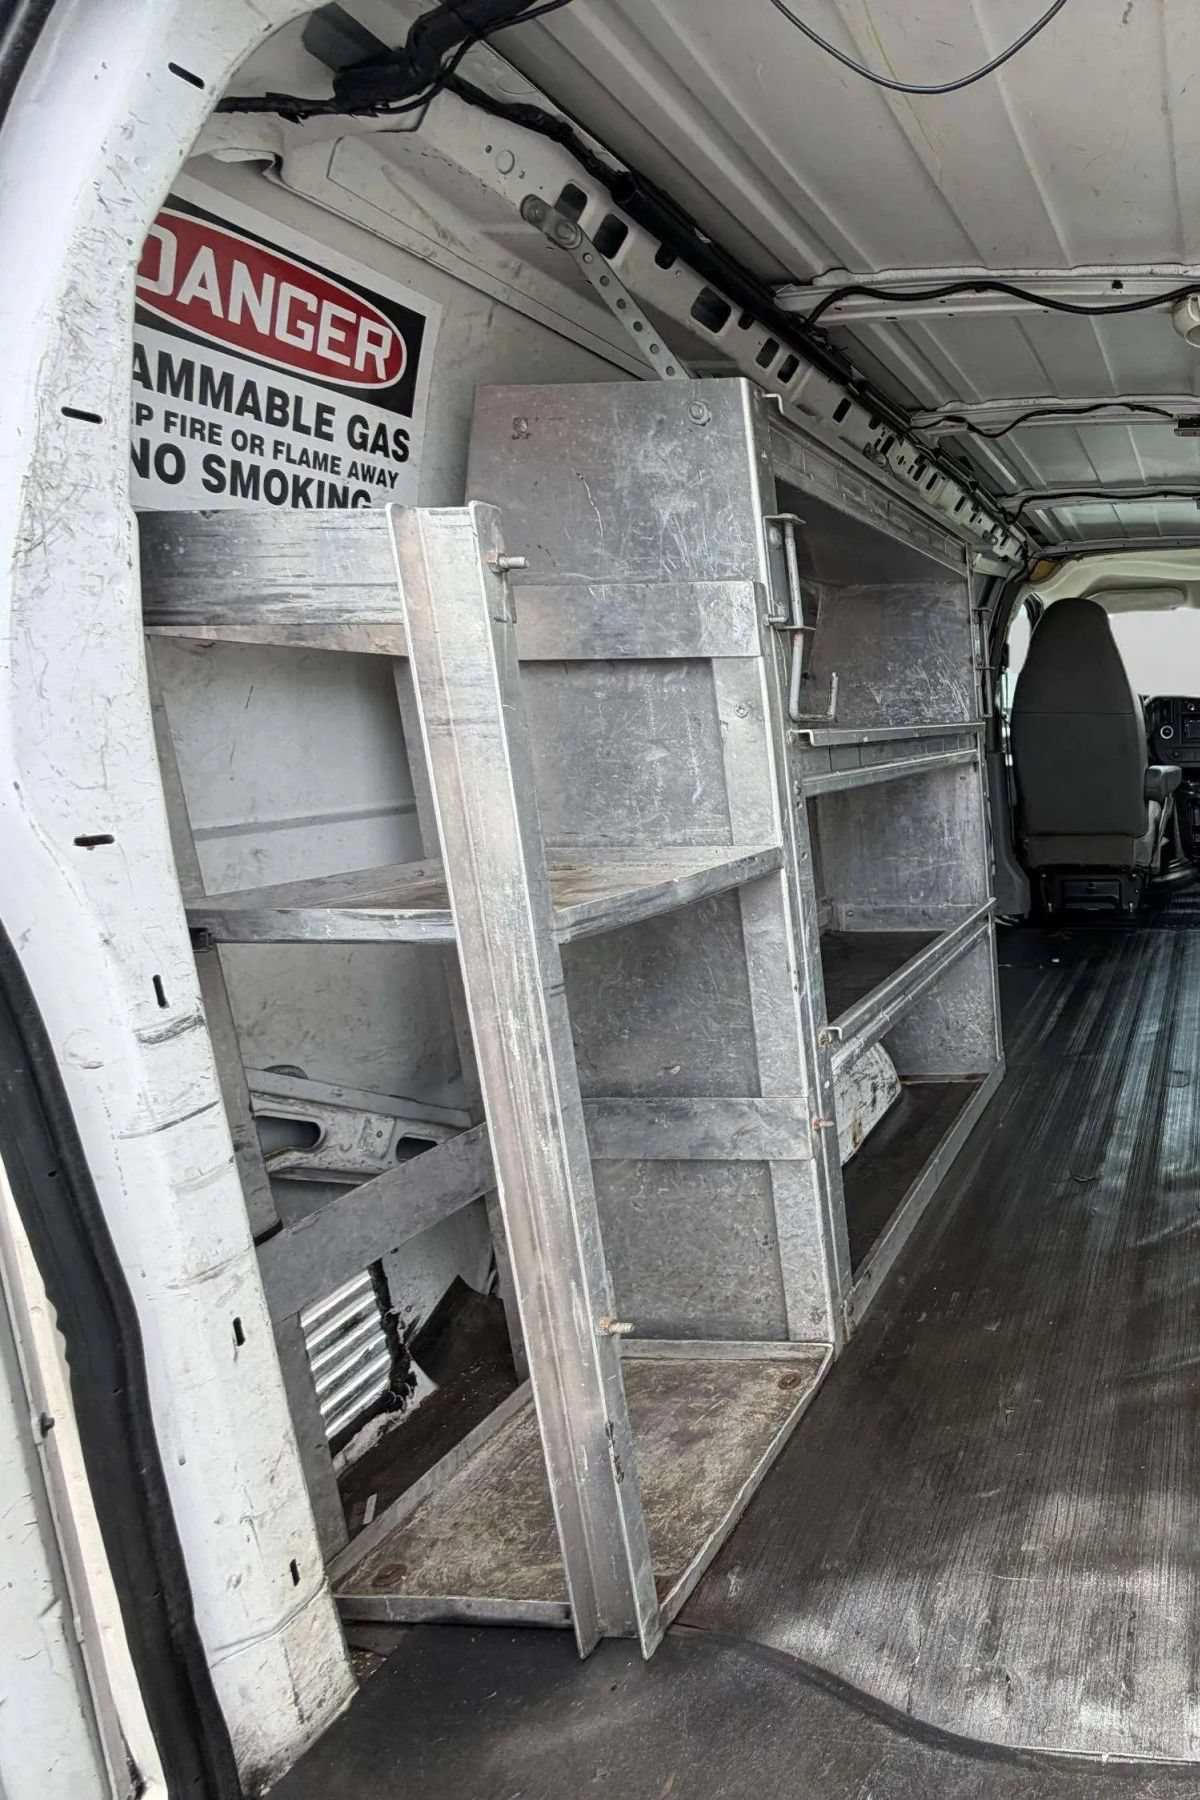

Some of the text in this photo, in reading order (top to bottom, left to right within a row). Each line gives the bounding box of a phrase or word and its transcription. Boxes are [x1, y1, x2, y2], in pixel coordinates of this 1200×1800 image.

[136, 223, 392, 381] DANGER
[133, 341, 411, 462] AMMABLE GAS
[163, 409, 223, 447] FIRE
[231, 429, 265, 457] OR
[273, 440, 342, 476] FLAME
[347, 460, 400, 490] AWAY
[131, 437, 186, 485] NO
